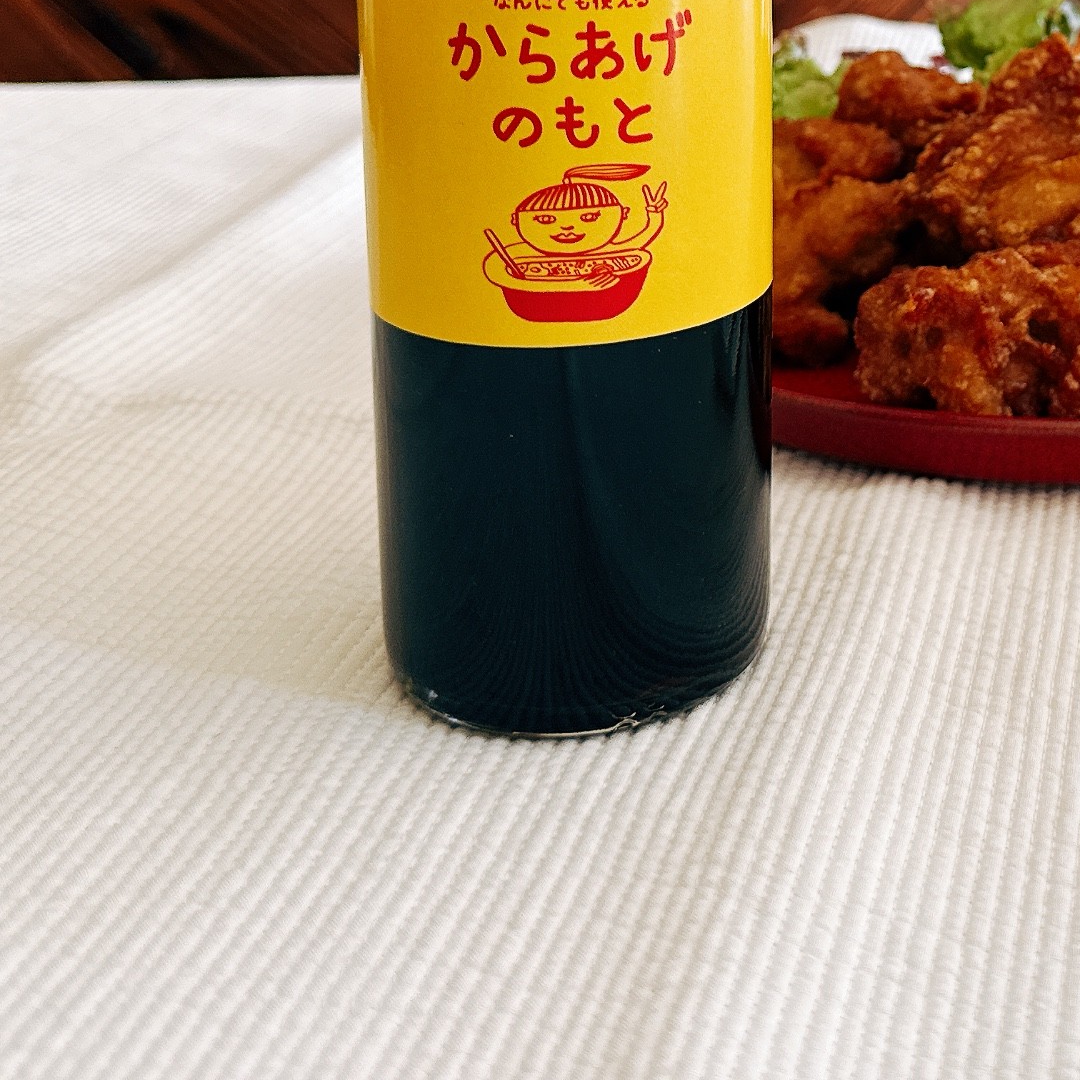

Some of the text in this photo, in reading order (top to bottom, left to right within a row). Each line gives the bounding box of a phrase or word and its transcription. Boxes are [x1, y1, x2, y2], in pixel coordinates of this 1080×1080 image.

[447, 9, 693, 85] からあげ
[492, 95, 654, 149] のもと
